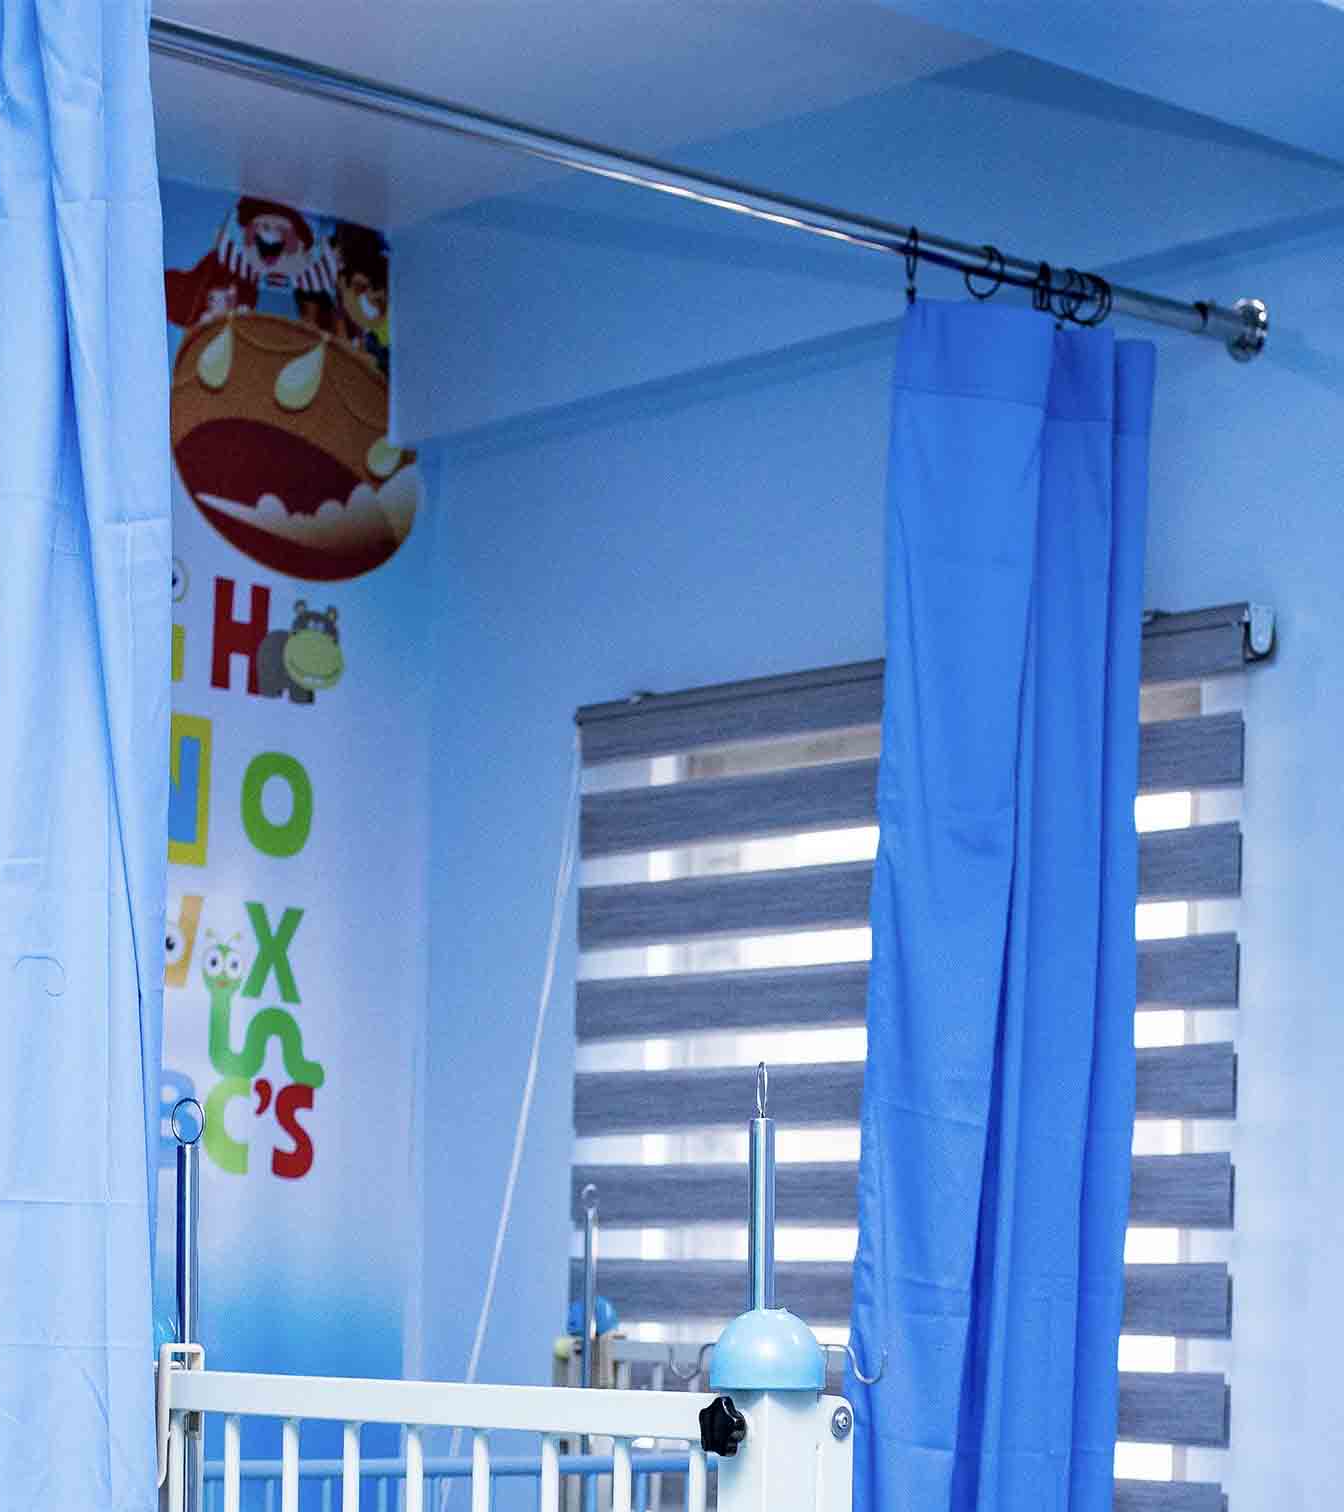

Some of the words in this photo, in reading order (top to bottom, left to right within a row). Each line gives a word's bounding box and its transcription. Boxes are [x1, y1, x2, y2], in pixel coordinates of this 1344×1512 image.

[211, 576, 271, 695] H
[240, 751, 313, 858] O
[241, 901, 305, 1005] X
